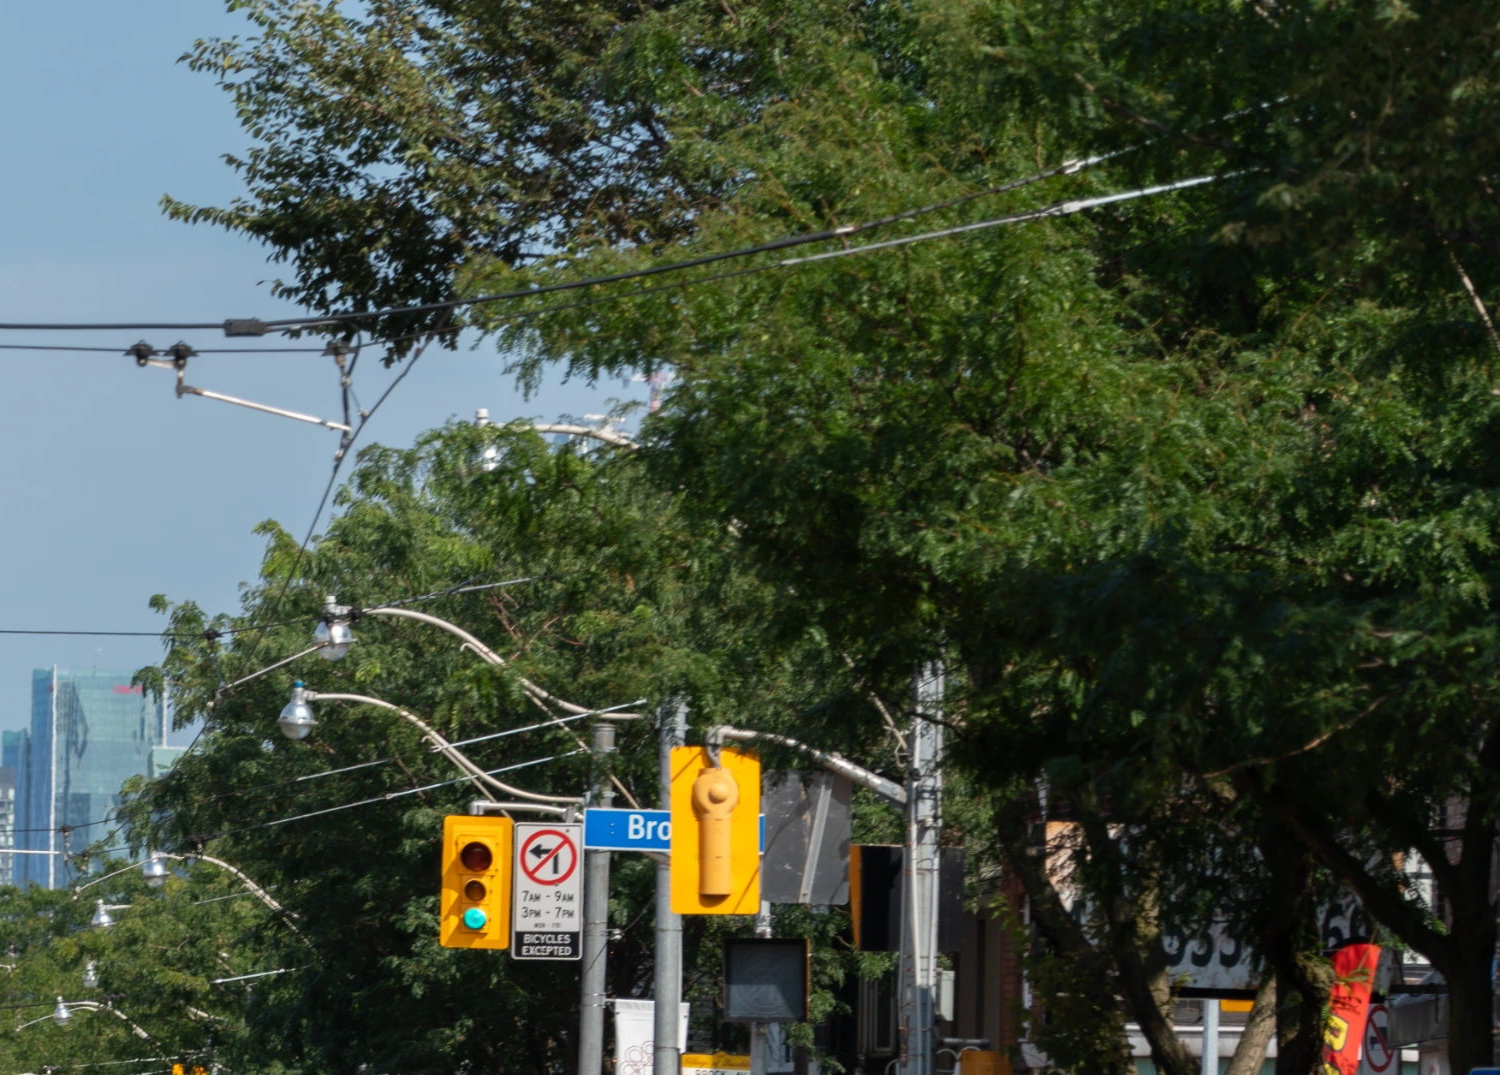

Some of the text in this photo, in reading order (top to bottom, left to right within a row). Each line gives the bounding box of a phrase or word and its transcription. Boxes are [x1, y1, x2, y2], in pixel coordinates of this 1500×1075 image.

[522, 890, 541, 902] 7AM
[554, 890, 575, 903] 9AM
[521, 906, 541, 918] 3PM
[555, 906, 575, 919] 7PM
[523, 933, 572, 944] BICYCLES
[521, 945, 573, 956] EXCEPTED
